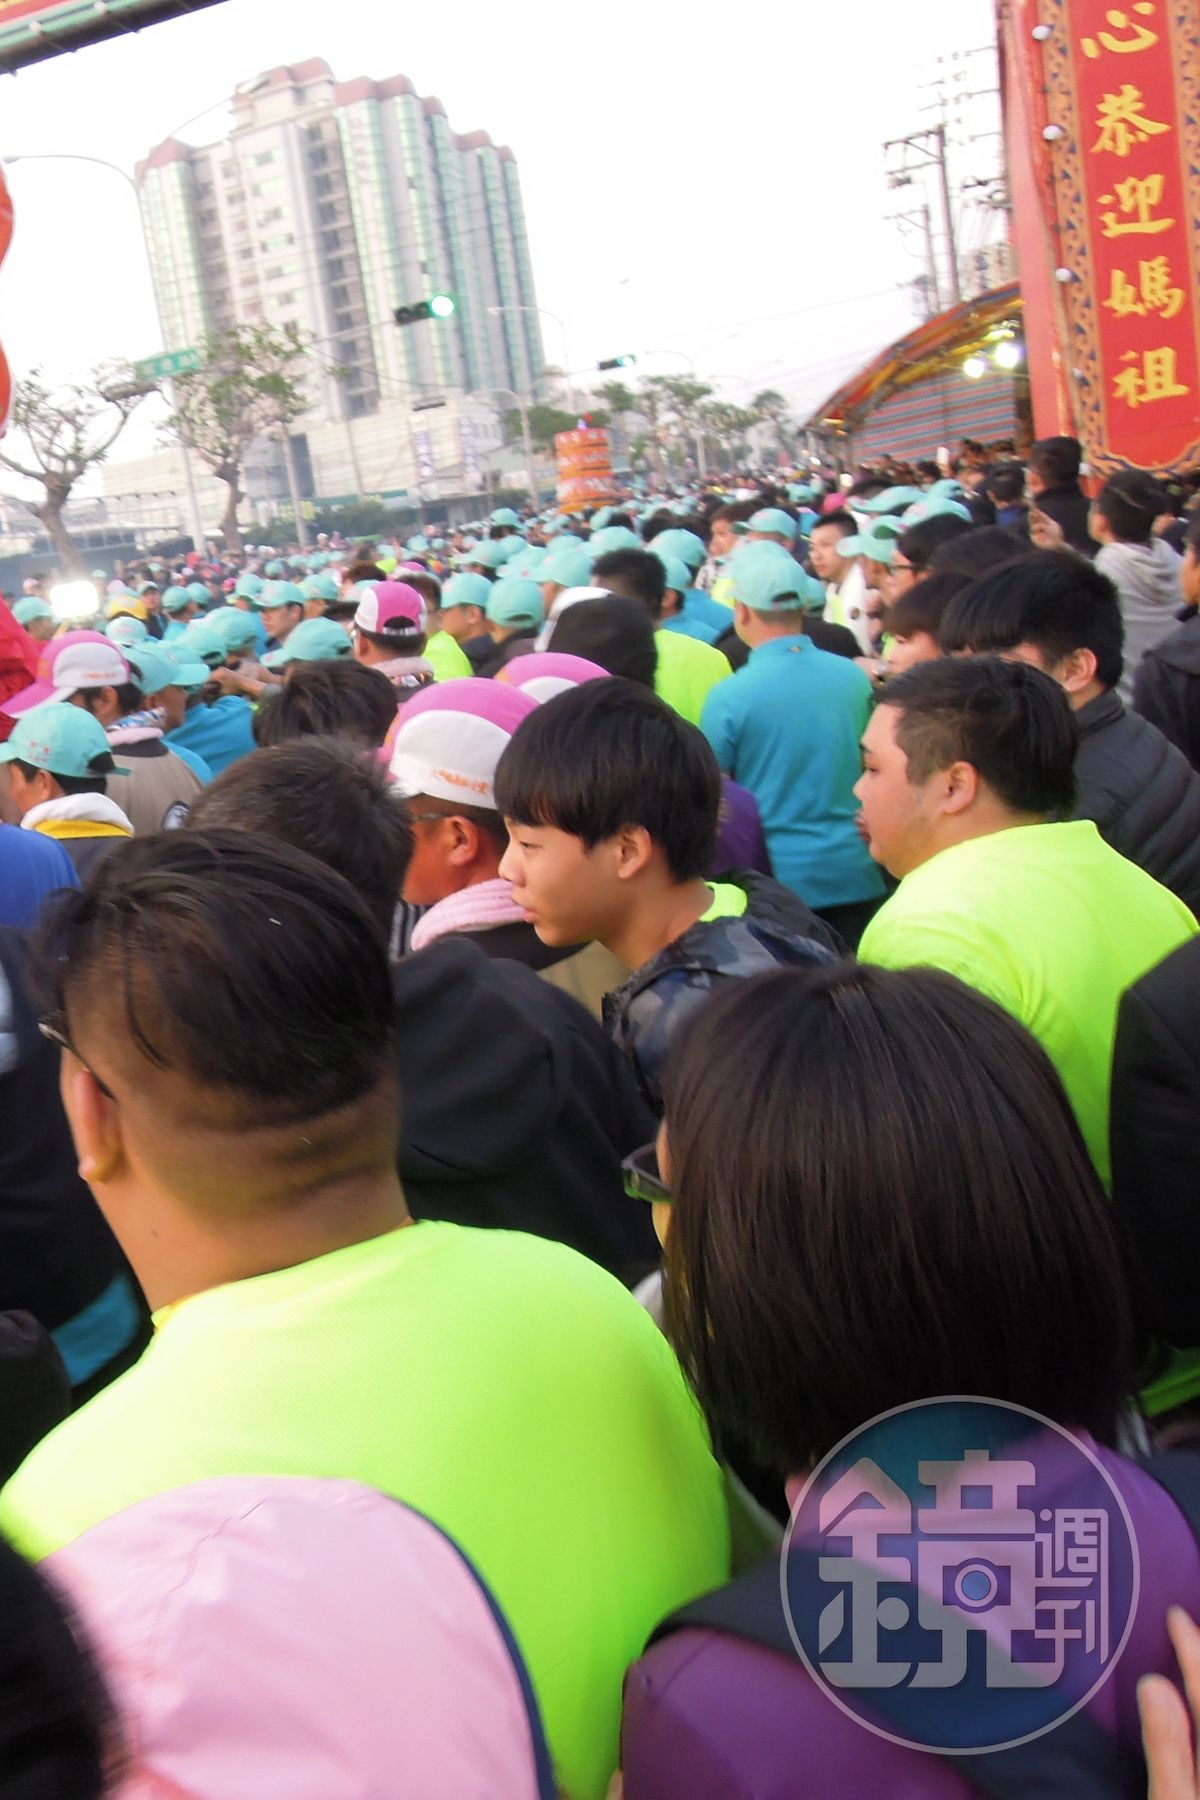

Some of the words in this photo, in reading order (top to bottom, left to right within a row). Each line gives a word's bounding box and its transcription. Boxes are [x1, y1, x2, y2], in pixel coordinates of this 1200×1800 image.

[1080, 1, 1191, 408] 心恭迎媽祖
